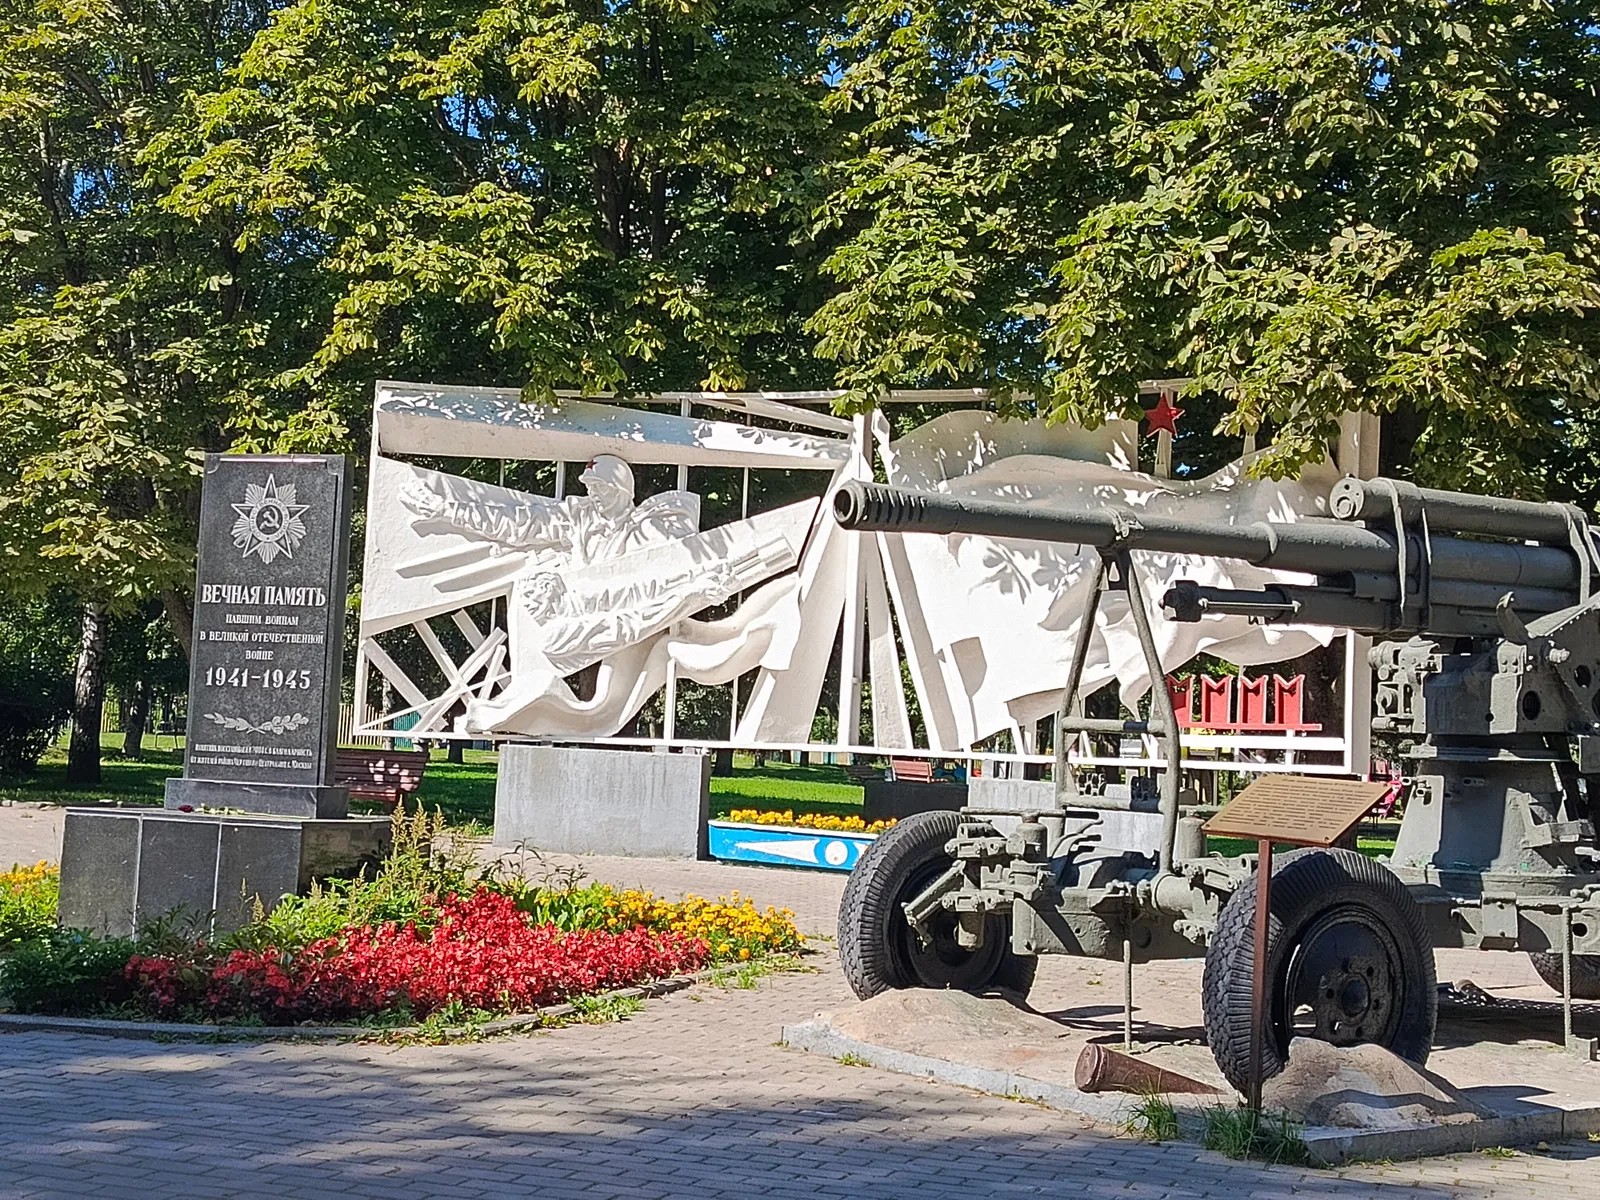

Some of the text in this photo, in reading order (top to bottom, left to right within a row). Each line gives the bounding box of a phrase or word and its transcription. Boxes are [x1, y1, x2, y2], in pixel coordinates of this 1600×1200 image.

[201, 584, 326, 607] ВЕЧНАЯ ПАМЯТЬ
[225, 614, 299, 626] ПАВШИМ ВОИНАМ
[199, 629, 324, 645] В ВЕЛИКОЙ ОТЕЧЕСТВЕННОЙ
[245, 647, 274, 661] ВОЙНЕ
[205, 667, 311, 689] 1941-1945
